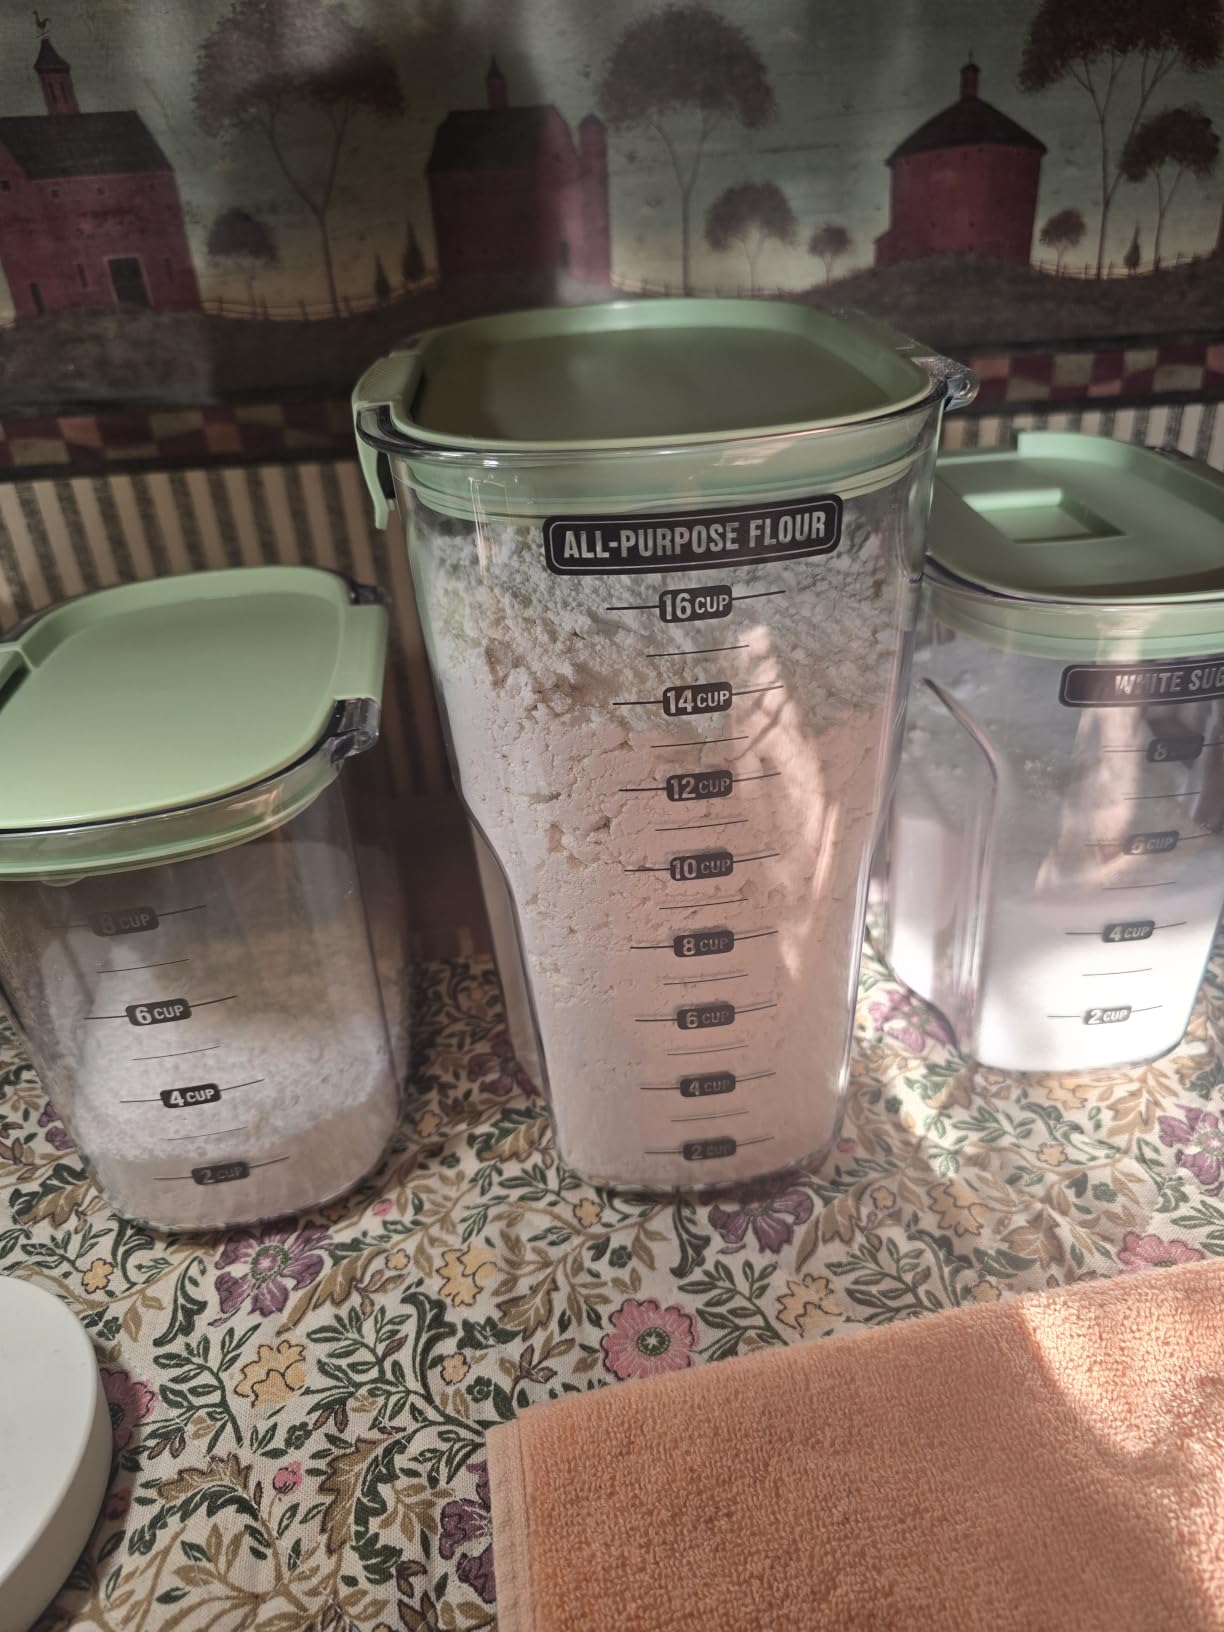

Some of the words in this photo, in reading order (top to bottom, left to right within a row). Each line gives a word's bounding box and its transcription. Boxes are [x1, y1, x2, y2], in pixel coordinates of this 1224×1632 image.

[563, 522, 739, 559] ALL-PURPOSE
[749, 511, 826, 547] FLOUR
[662, 592, 692, 620] 16
[694, 594, 730, 614] CUP
[1115, 671, 1184, 695] WHITE
[666, 689, 695, 714] 14
[696, 690, 730, 708] CUP
[670, 777, 696, 799] 12
[698, 778, 730, 793] CUP
[672, 859, 697, 880] 10
[701, 859, 731, 874] CUP
[119, 912, 150, 929] CUP
[1109, 926, 1122, 941] 4
[1124, 925, 1149, 938] CUP
[682, 937, 696, 956] 8
[700, 936, 729, 952] CUP
[135, 1006, 152, 1024] 6
[153, 1004, 184, 1020] CUP
[685, 1011, 699, 1028] 6
[702, 1010, 730, 1024] CUP
[1088, 1009, 1102, 1025] 2
[1102, 1009, 1128, 1022] CUP
[169, 1091, 185, 1107] 4
[185, 1088, 215, 1103] CUP
[689, 1080, 700, 1096] 4
[691, 1145, 703, 1160] 2
[201, 1169, 215, 1183] 2
